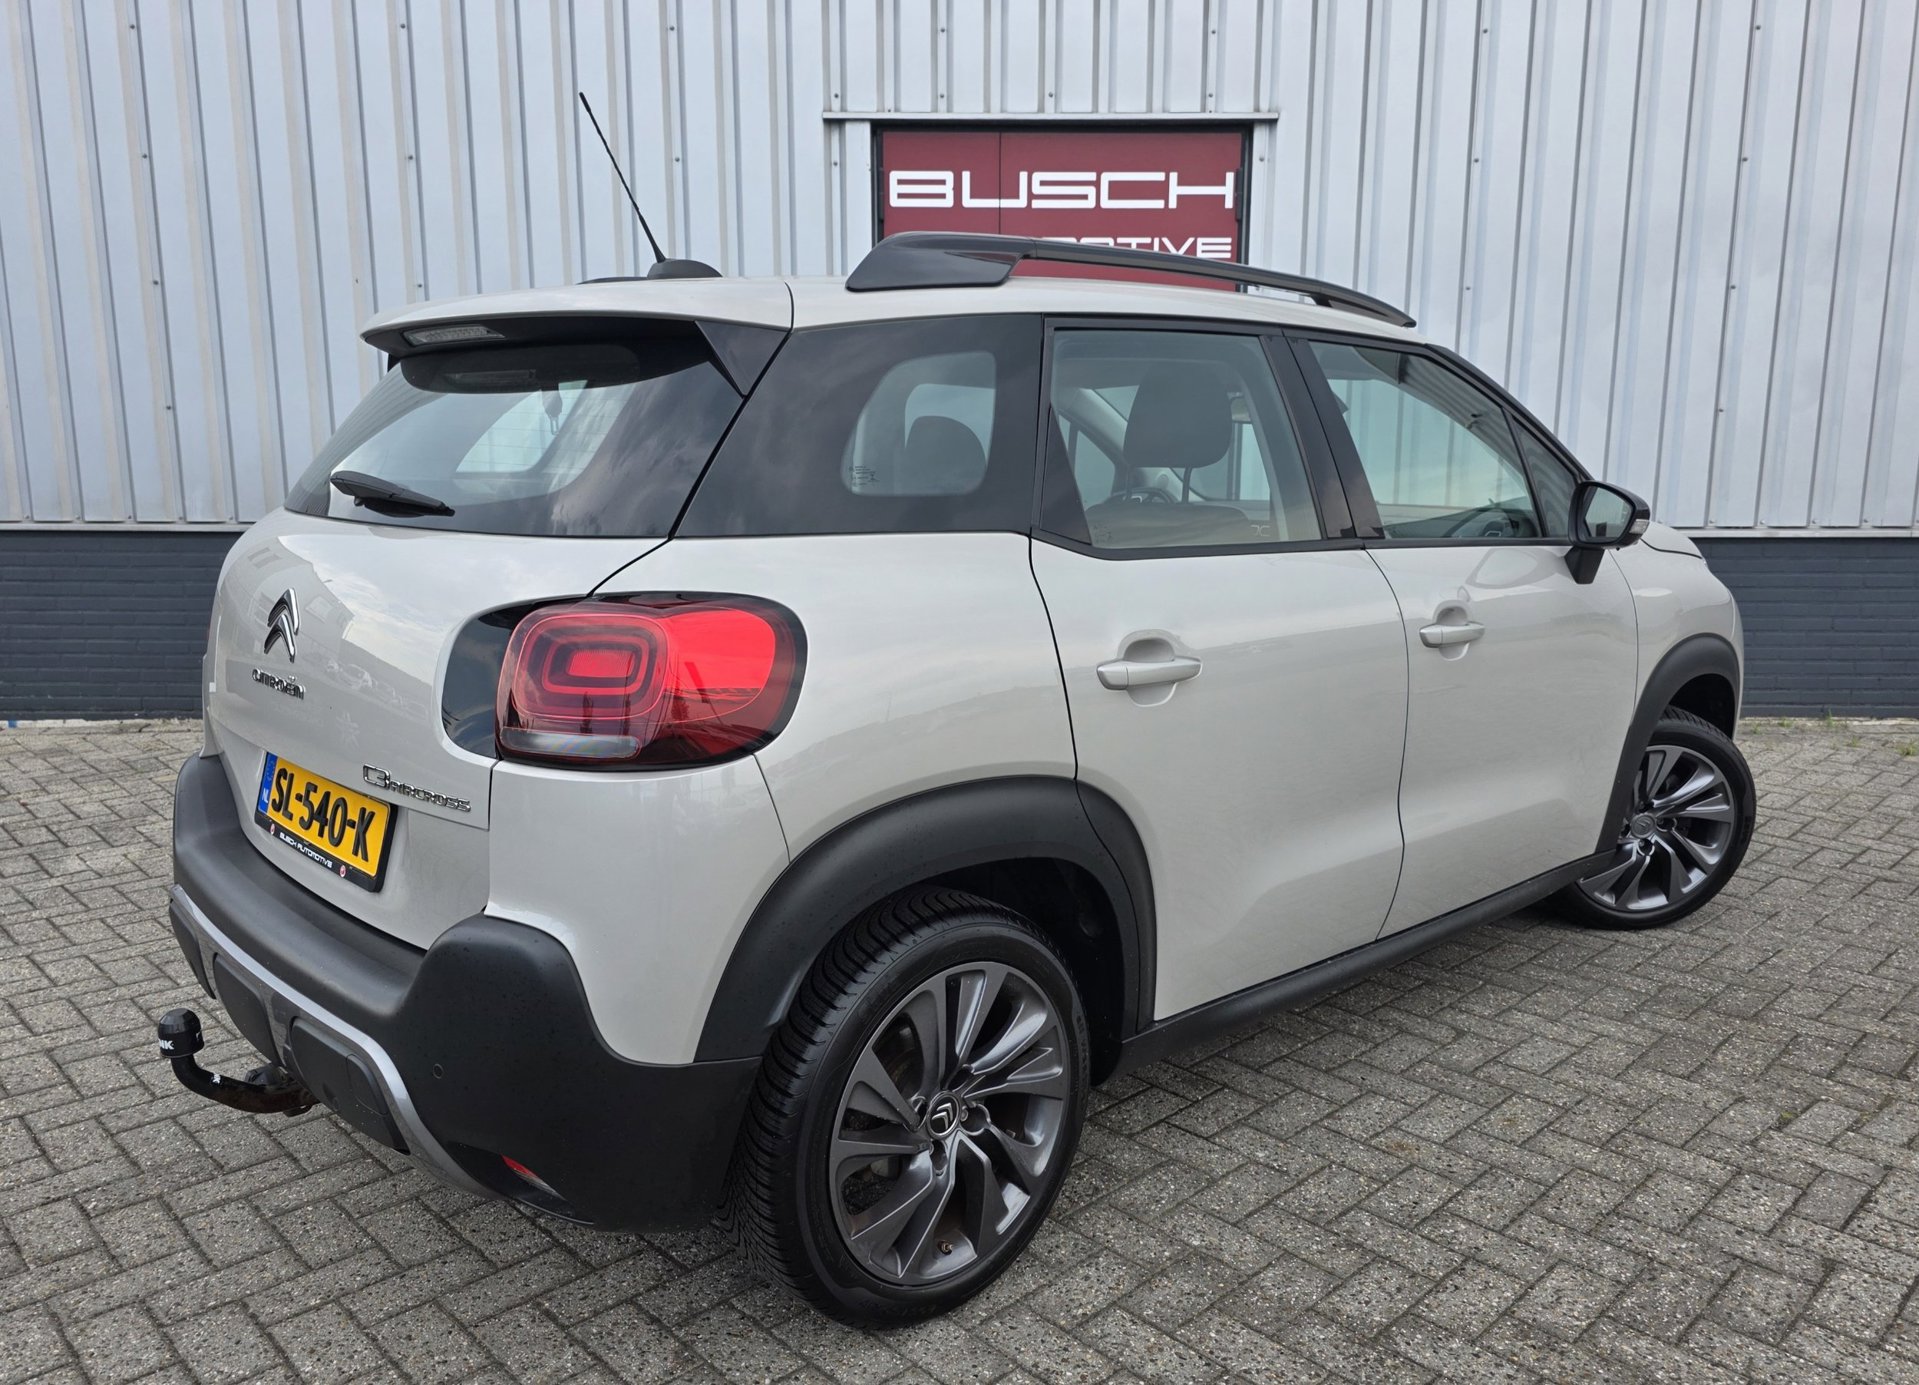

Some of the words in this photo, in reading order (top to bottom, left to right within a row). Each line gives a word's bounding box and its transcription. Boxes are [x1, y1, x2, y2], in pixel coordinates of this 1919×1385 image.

[889, 170, 1234, 209] BUSCH
[262, 787, 269, 804] NL
[271, 767, 376, 863] SL-540-K
[297, 843, 333, 869] AUTOMOTIVE
